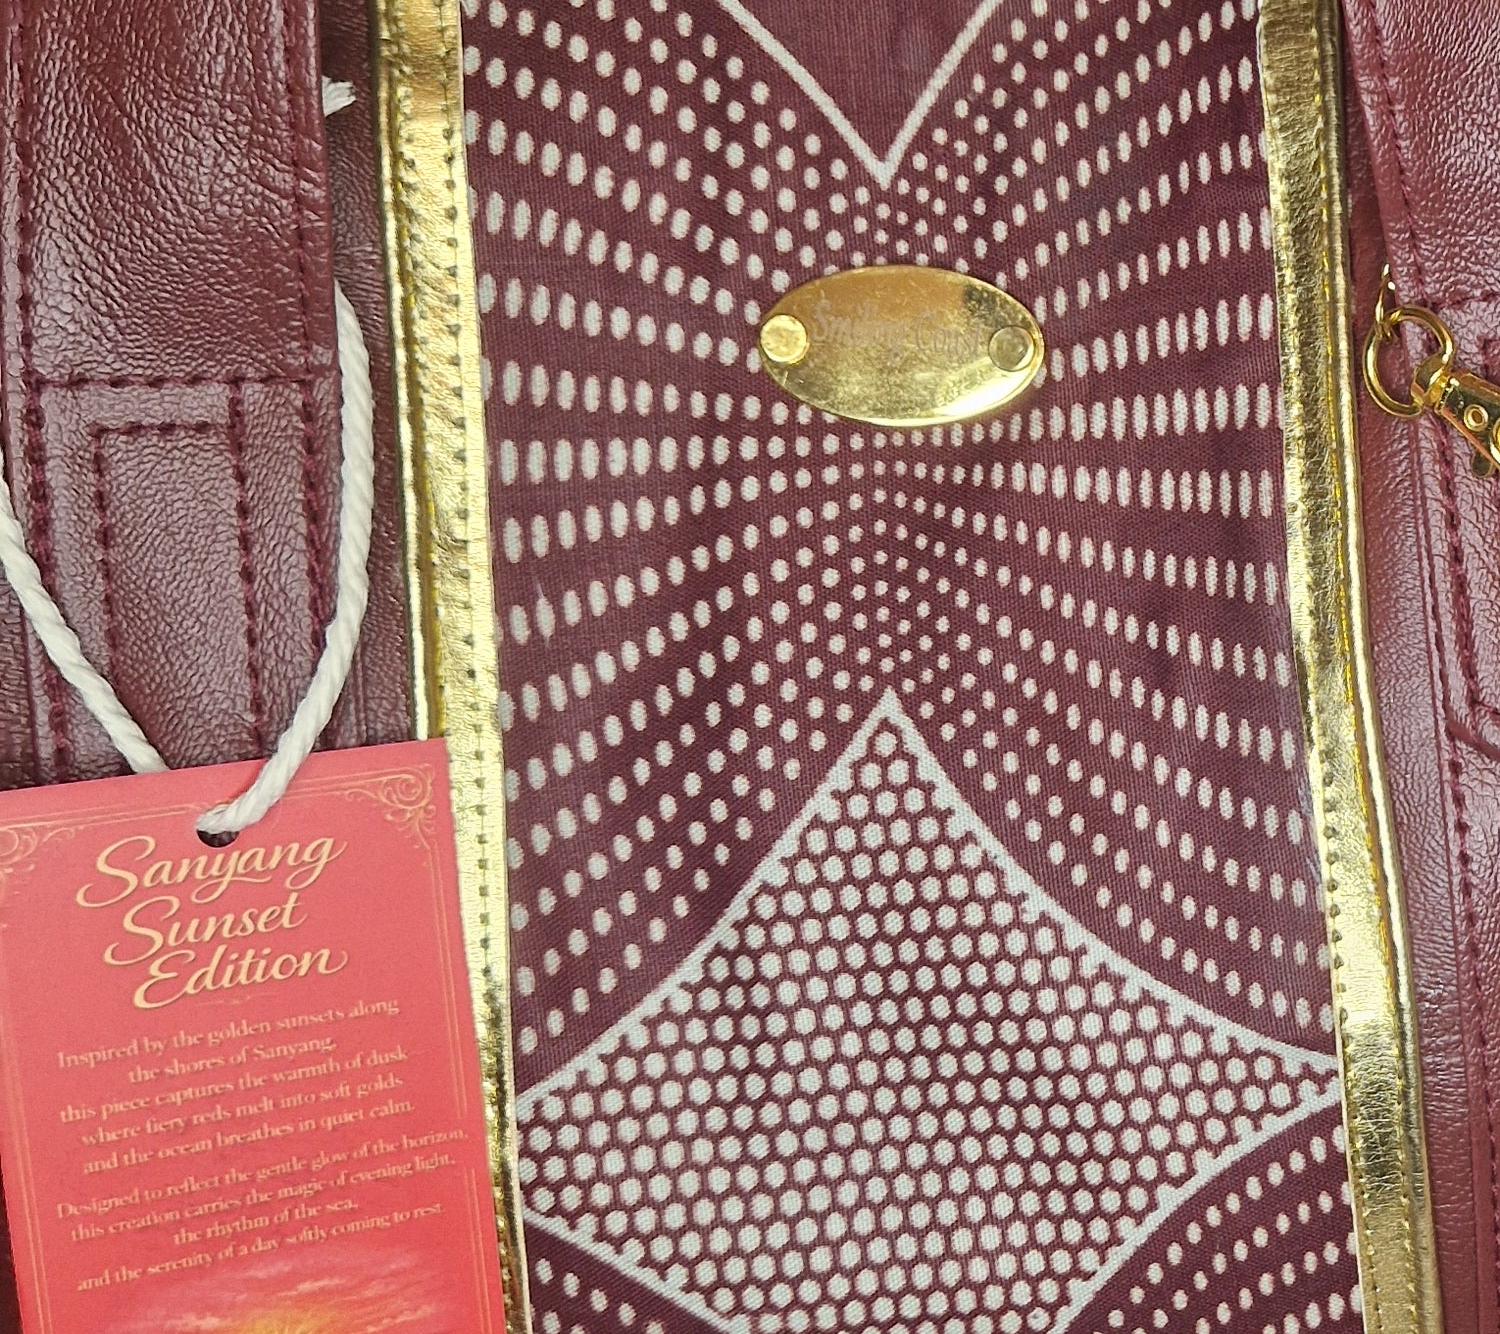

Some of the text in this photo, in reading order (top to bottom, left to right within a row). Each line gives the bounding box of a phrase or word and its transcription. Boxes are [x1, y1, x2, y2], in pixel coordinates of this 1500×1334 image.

[75, 835, 348, 908] Sanyang
[104, 891, 308, 965] Sunset
[132, 944, 349, 1009] Edition
[58, 999, 400, 1068] Inspired by the golden sunsets along
[129, 1066, 160, 1085] the
[164, 1057, 225, 1077] shores
[230, 1045, 249, 1064] of
[60, 1044, 408, 1124] this piece captures the warmth of dusk
[81, 1072, 404, 1146] where fiery reds melt into soft golds
[84, 1151, 118, 1174] and
[123, 1147, 154, 1167] the
[158, 1139, 212, 1160] ocean
[216, 1122, 295, 1148] breathes
[299, 1117, 316, 1132] in
[321, 1108, 364, 1131] quiet
[56, 1187, 140, 1218] Designed
[145, 1188, 162, 1201] to
[167, 1176, 220, 1197] reflect
[224, 1168, 252, 1185] the
[256, 1155, 308, 1182] gentle
[311, 1150, 349, 1172] glow
[353, 1140, 371, 1159] of
[373, 1138, 399, 1156] the
[71, 1223, 104, 1242] this
[109, 1210, 180, 1234] creation
[185, 1196, 241, 1218] carries
[246, 1188, 273, 1205] the
[278, 1178, 327, 1198] magic
[331, 1170, 350, 1188] of
[350, 1163, 413, 1184] evening
[77, 1268, 111, 1292] and
[115, 1265, 143, 1284] the
[147, 1250, 213, 1276] serenity
[217, 1241, 237, 1260] of
[239, 1244, 249, 1257] a
[252, 1238, 279, 1253] day
[285, 1223, 328, 1245] softly
[331, 1214, 391, 1237] coming
[392, 1210, 410, 1224] to
[173, 1227, 201, 1246] the
[206, 1215, 270, 1240] rhythm
[274, 1207, 291, 1224] of
[294, 1203, 322, 1221] the
